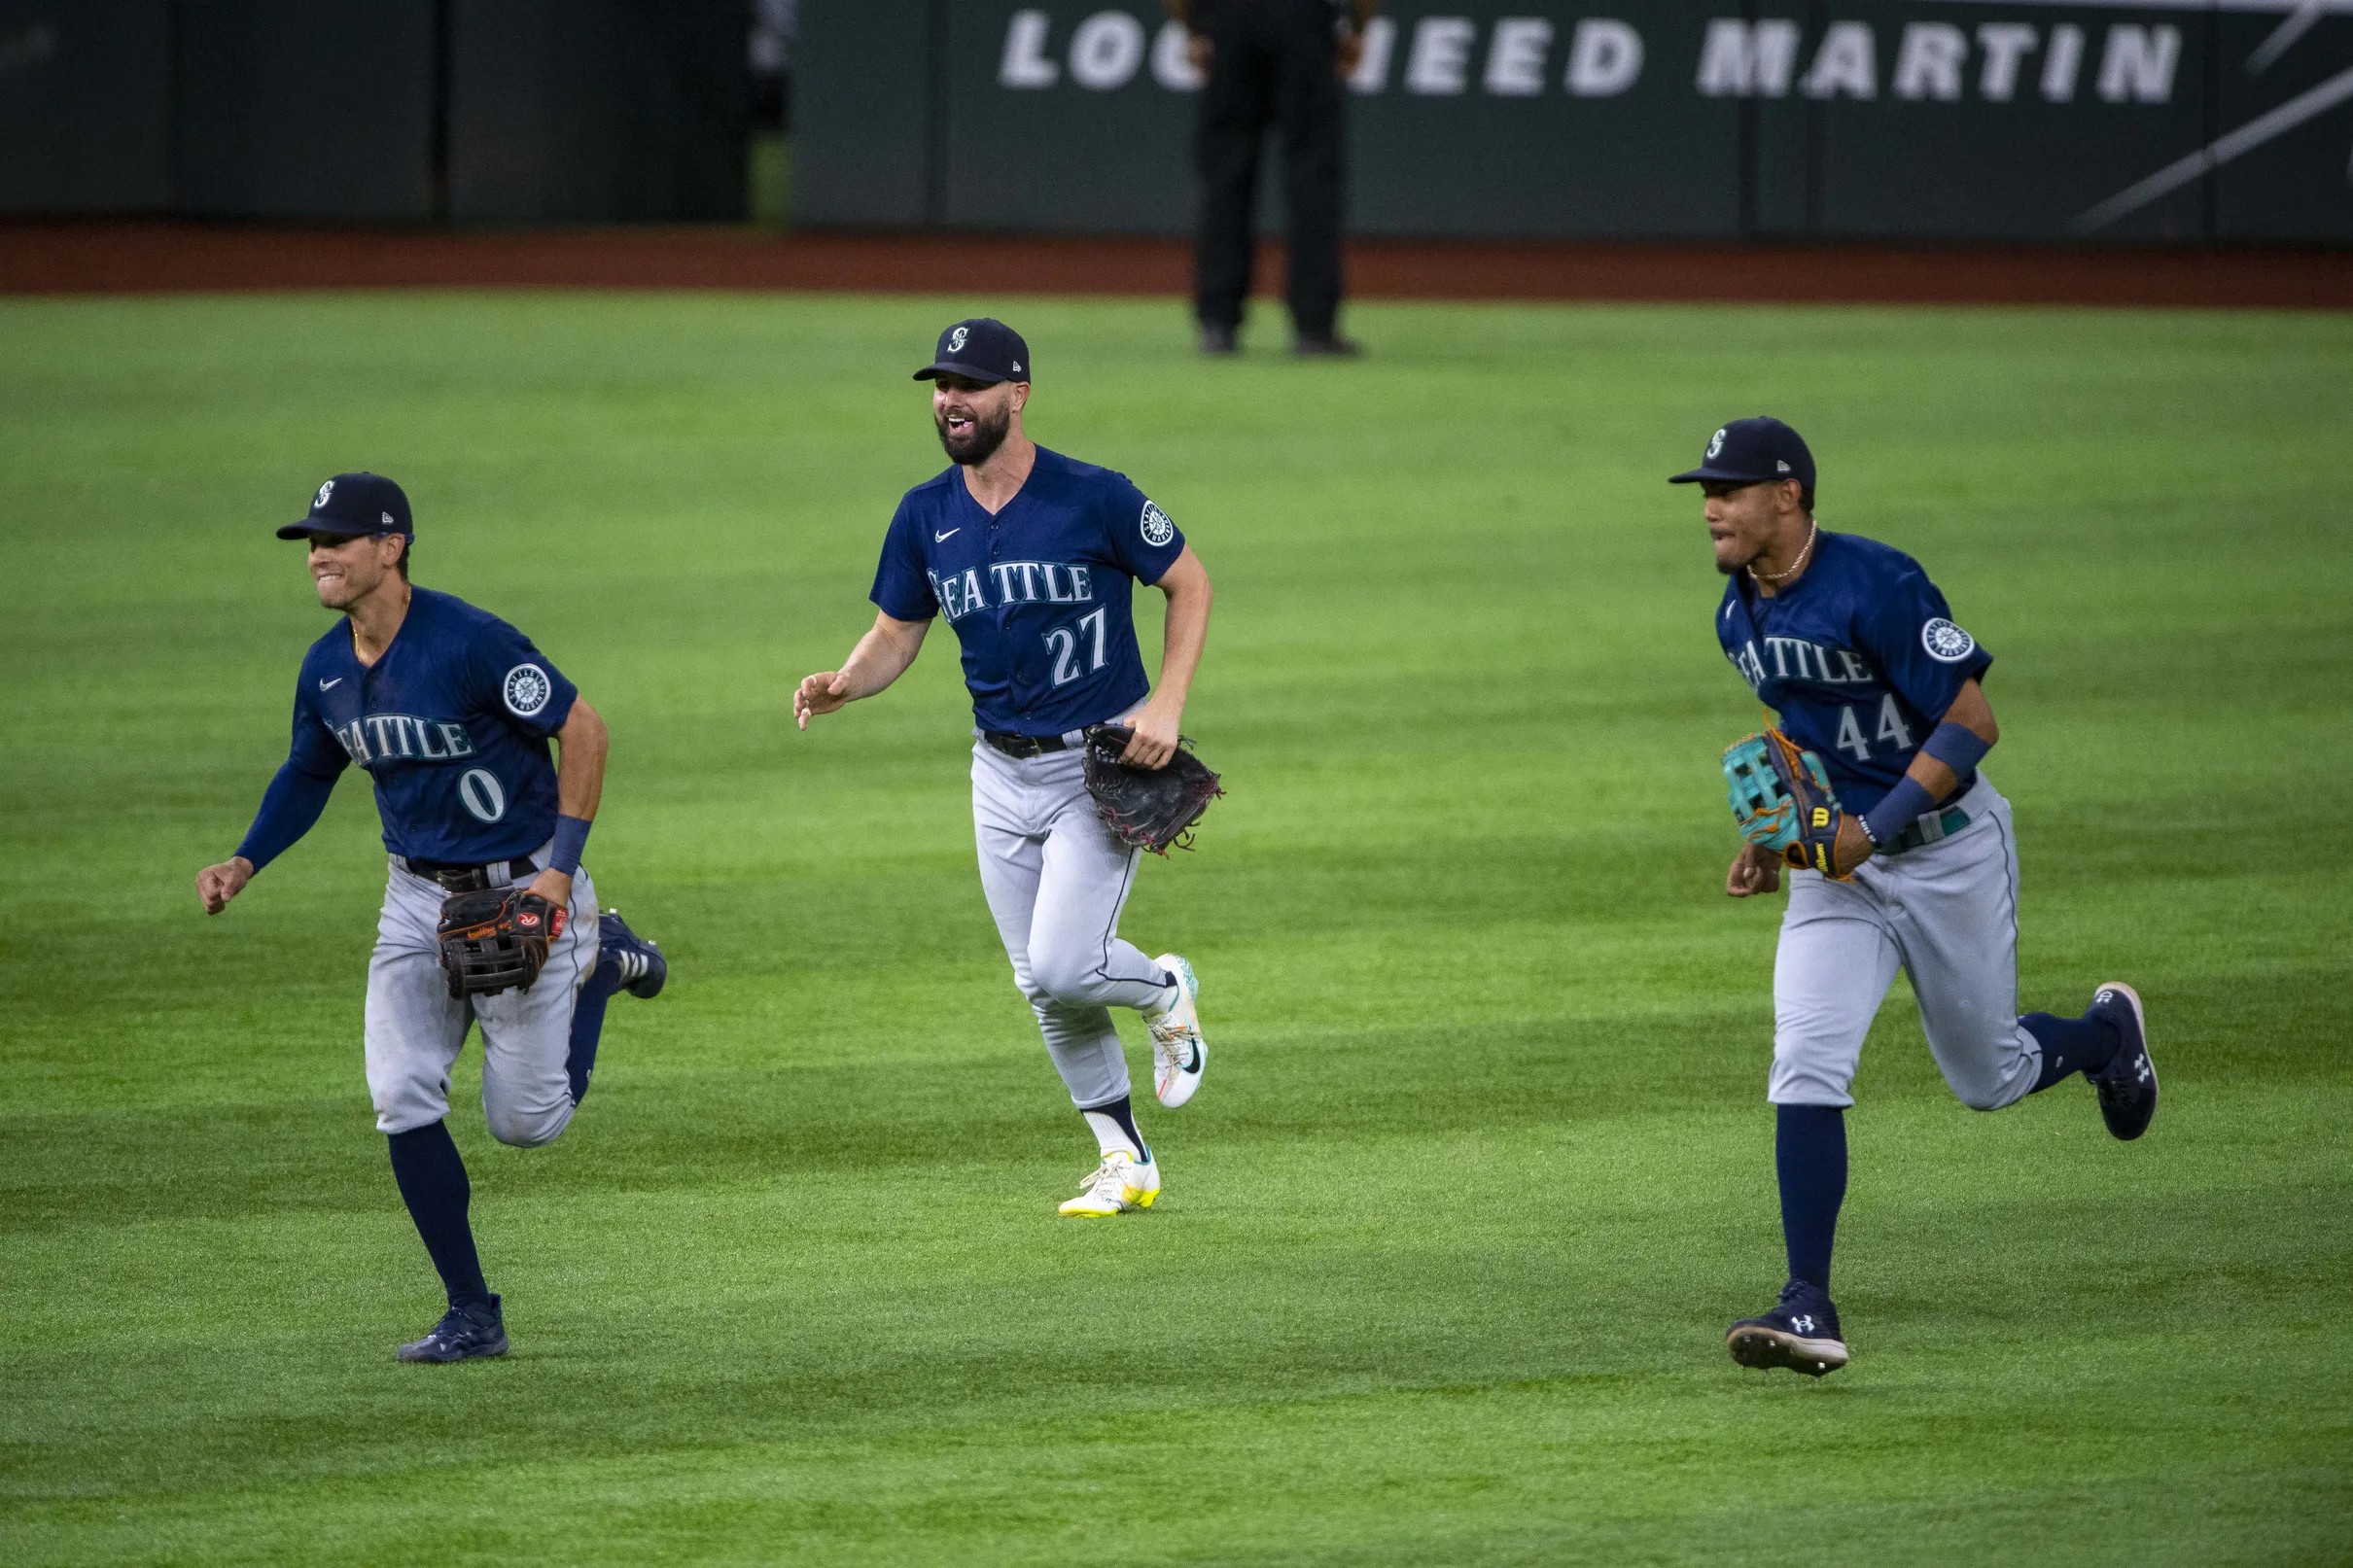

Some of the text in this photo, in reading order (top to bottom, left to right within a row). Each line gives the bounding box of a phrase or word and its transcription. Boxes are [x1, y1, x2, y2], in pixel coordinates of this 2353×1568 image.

[1694, 17, 2183, 104] MARTIN
[946, 327, 969, 352] S
[1706, 429, 1727, 459] S
[313, 480, 336, 509] S
[1041, 603, 1108, 689] 27
[1728, 634, 1875, 693] EATTLE
[323, 713, 476, 766] EATTLE
[1836, 691, 1914, 761] 44
[457, 766, 507, 823] 0
